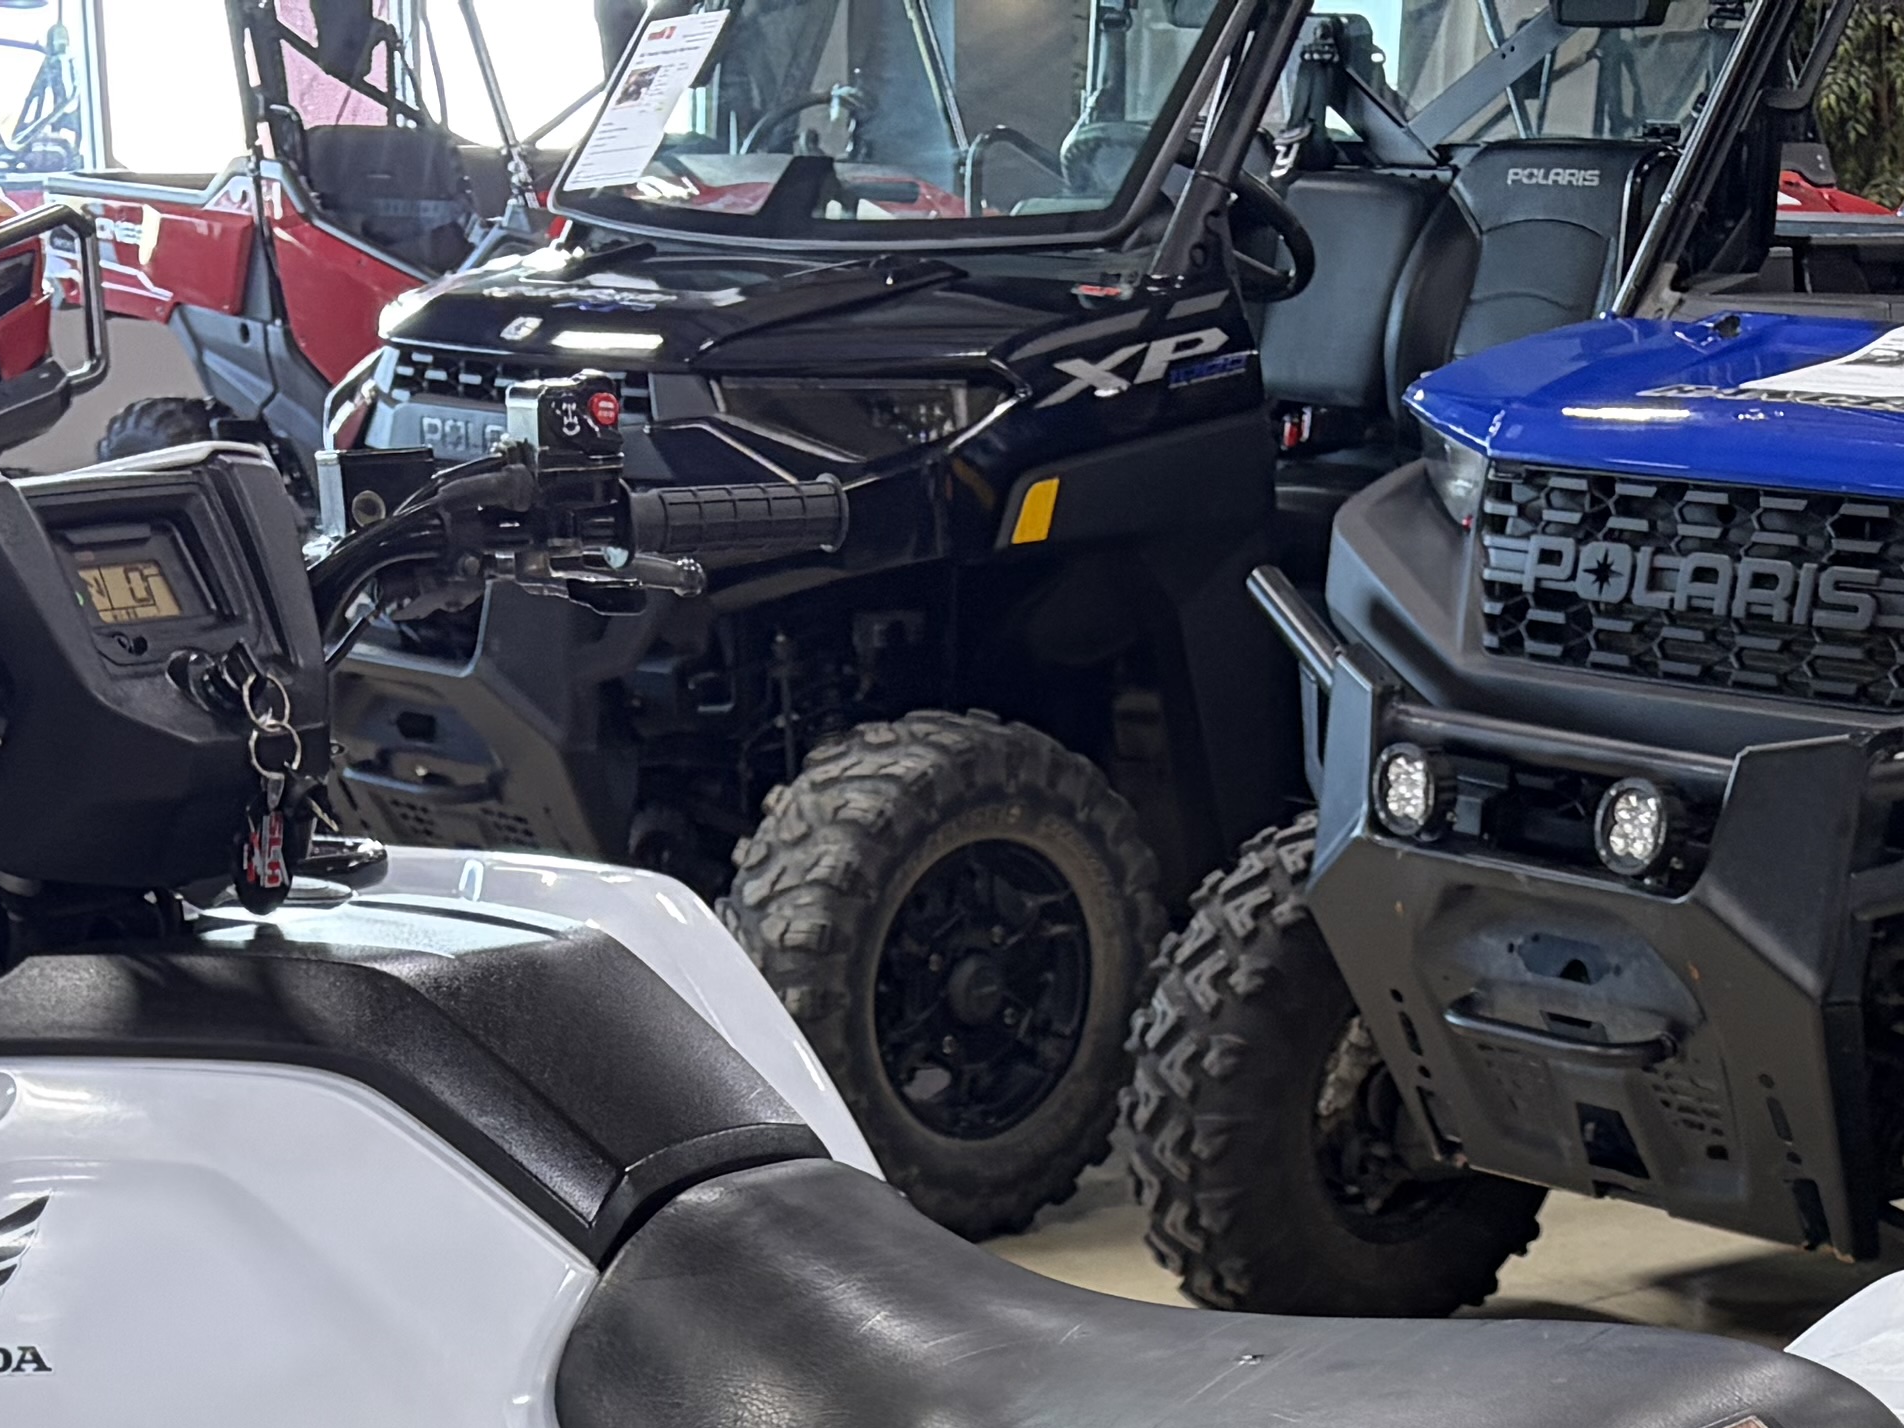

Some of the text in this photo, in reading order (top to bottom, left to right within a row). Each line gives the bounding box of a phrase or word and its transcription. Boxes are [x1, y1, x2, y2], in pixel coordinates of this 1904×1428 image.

[1507, 168, 1600, 187] POLARIS
[1033, 327, 1230, 409] XP
[422, 416, 506, 450] POLA
[1523, 534, 1882, 632] POLARIS
